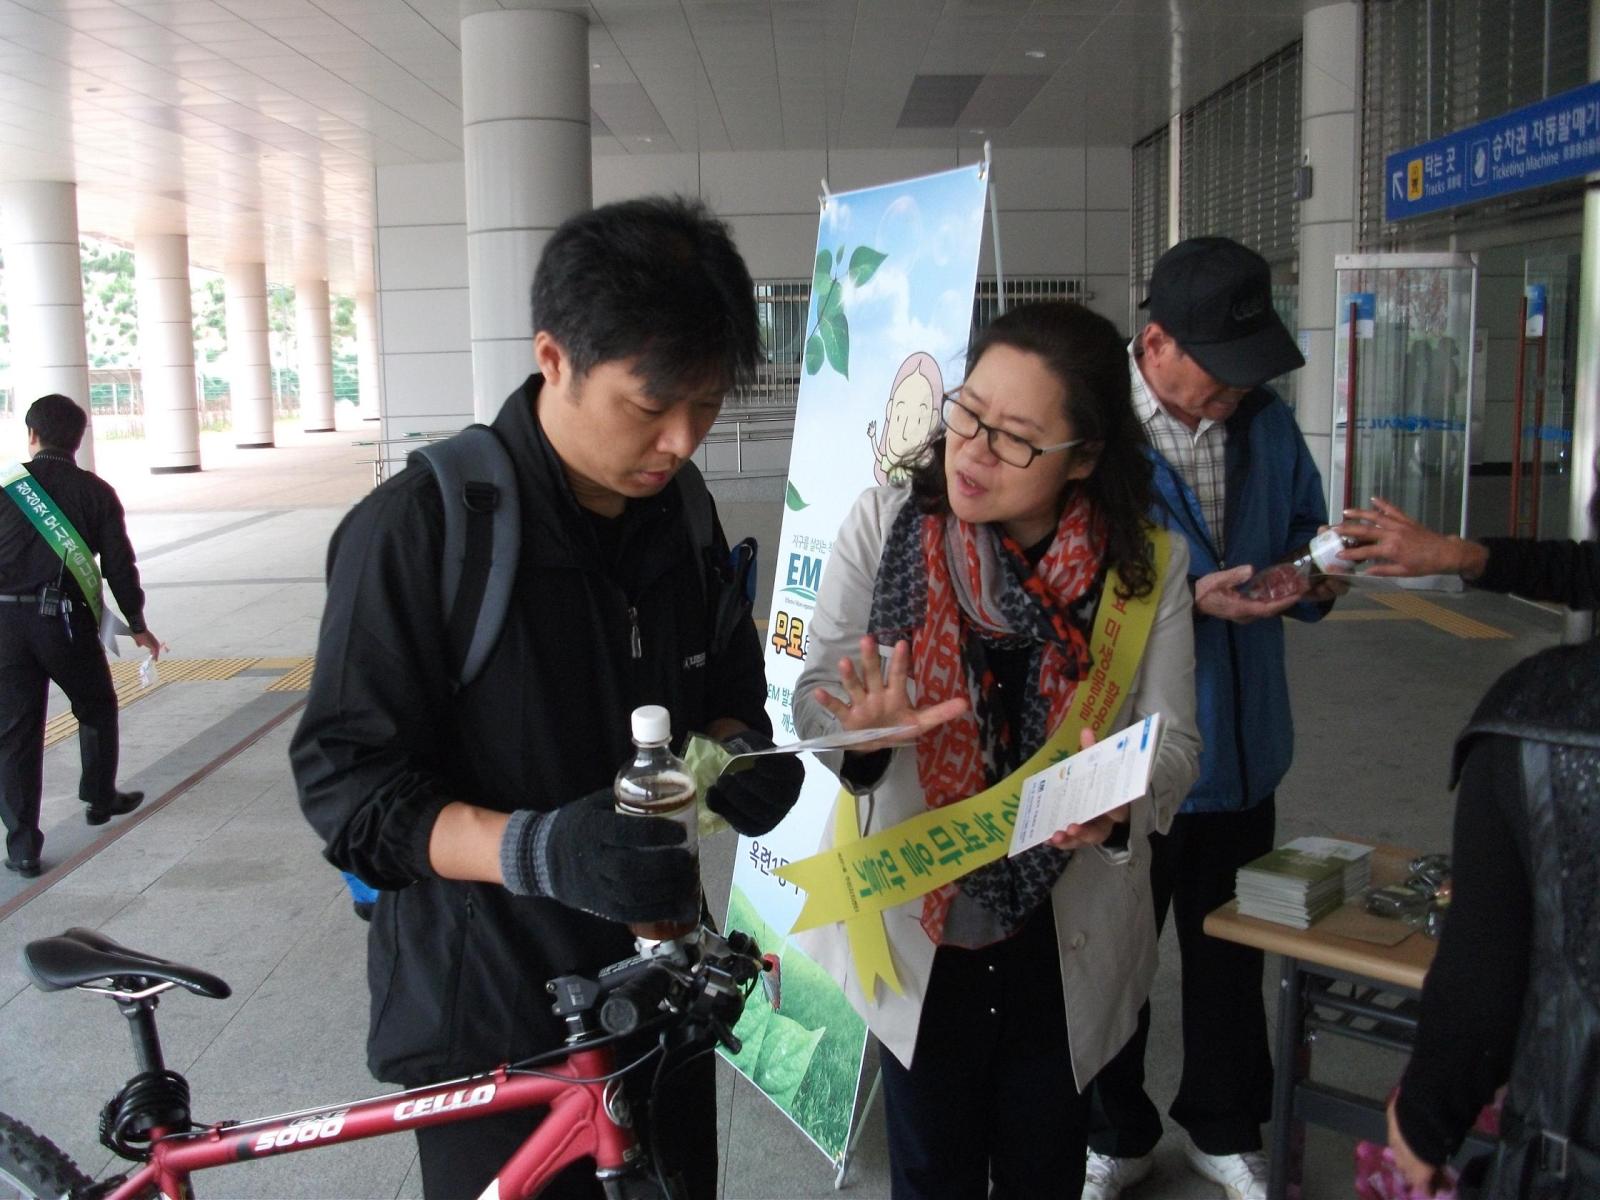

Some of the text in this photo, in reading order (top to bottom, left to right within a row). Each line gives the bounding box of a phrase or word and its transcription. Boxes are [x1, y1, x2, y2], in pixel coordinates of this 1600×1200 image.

[1492, 126, 1527, 161] 승차권
[1531, 101, 1599, 147] 자동발매기
[1425, 147, 1456, 178] 타는 곳
[1492, 151, 1559, 181] Ticketing Machine
[1425, 179, 1445, 196] Tracks
[17, 481, 50, 517] 정성껏
[792, 534, 809, 550] 지구를
[810, 537, 827, 553] 살리는
[786, 552, 822, 592] EM
[900, 812, 1006, 877] 녹색마을
[393, 1083, 497, 1121] CELLO
[254, 1117, 346, 1152] 5000
